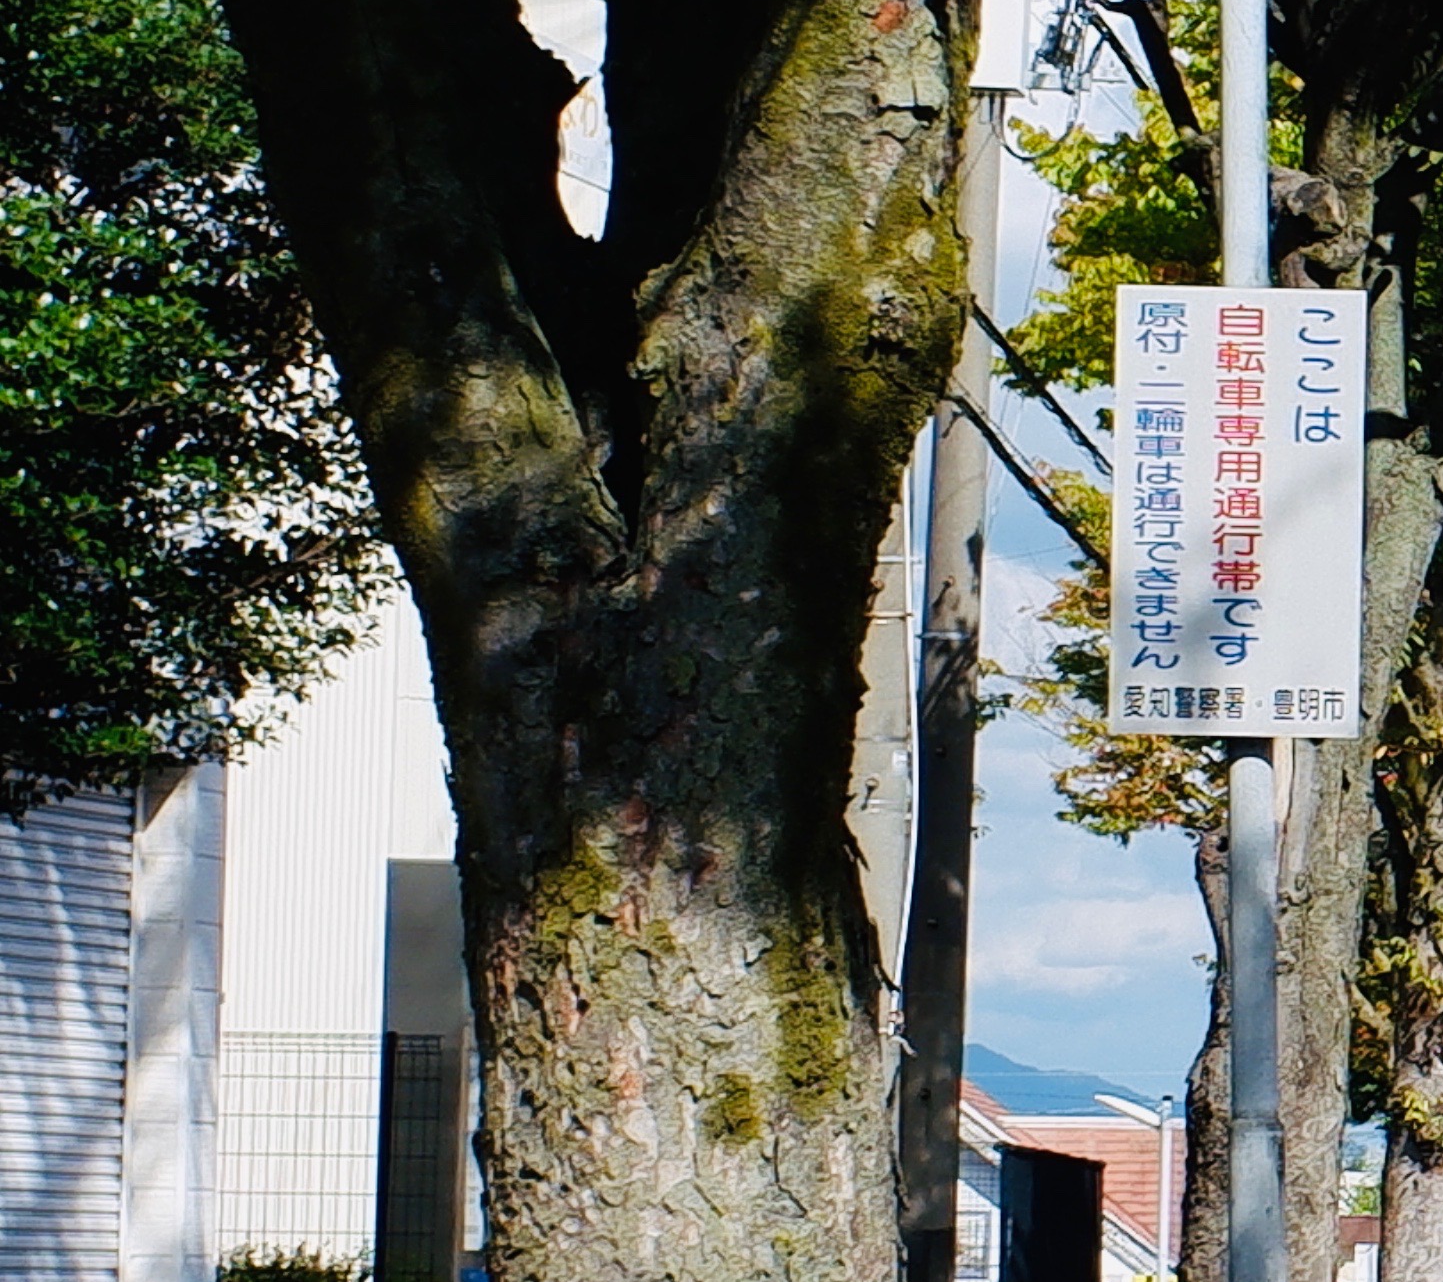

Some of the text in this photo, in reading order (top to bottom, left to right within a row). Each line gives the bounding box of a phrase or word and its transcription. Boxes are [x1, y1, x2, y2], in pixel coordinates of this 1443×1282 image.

[1131, 302, 1188, 669] 原付・二輪車は通行できません
[1210, 304, 1266, 665] 自転車専用通行帯です
[1294, 308, 1342, 444] ここは
